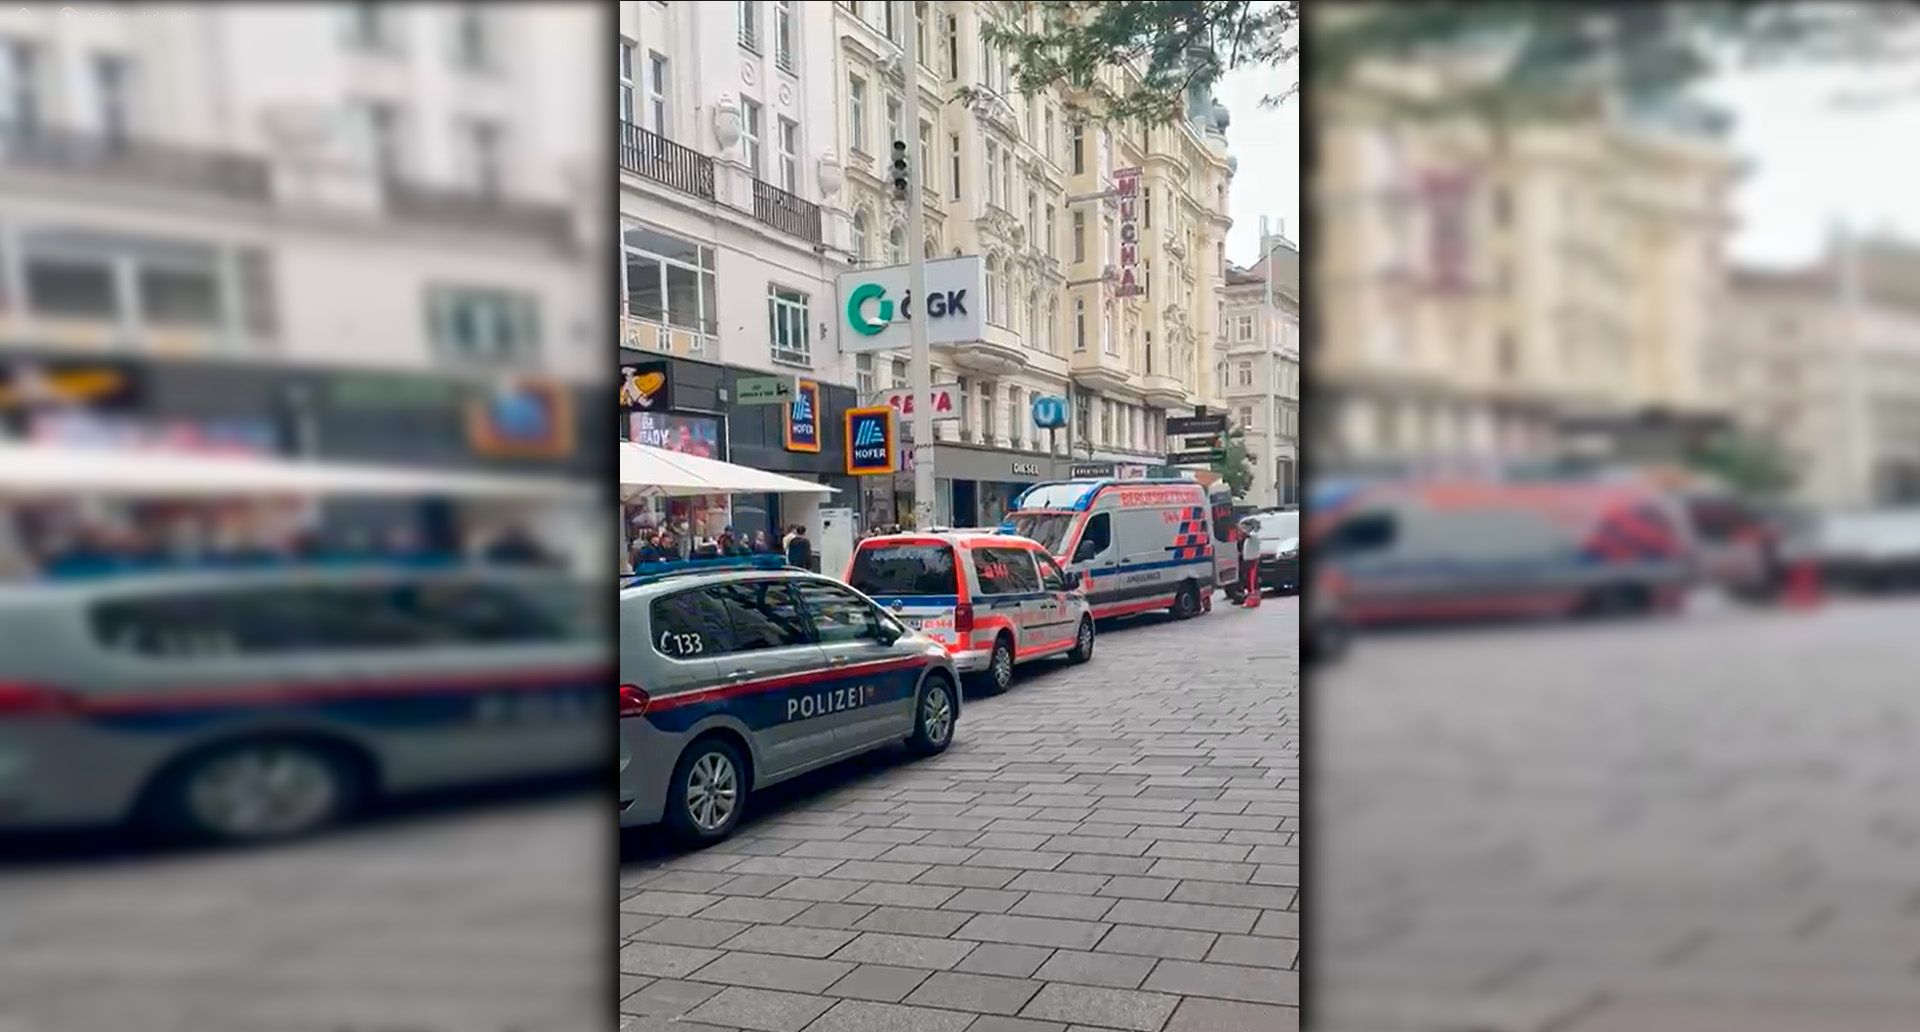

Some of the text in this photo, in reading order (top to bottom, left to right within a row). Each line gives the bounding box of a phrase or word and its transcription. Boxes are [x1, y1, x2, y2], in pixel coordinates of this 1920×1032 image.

[1118, 178, 1136, 285] MUCHA
[890, 391, 953, 414] SEA
[1037, 402, 1056, 421] U
[792, 423, 814, 434] HOFER
[855, 448, 886, 460] HOFER
[1013, 463, 1039, 475] DIESEL
[673, 632, 703, 654] 133
[788, 686, 864, 721] POLIZEI
